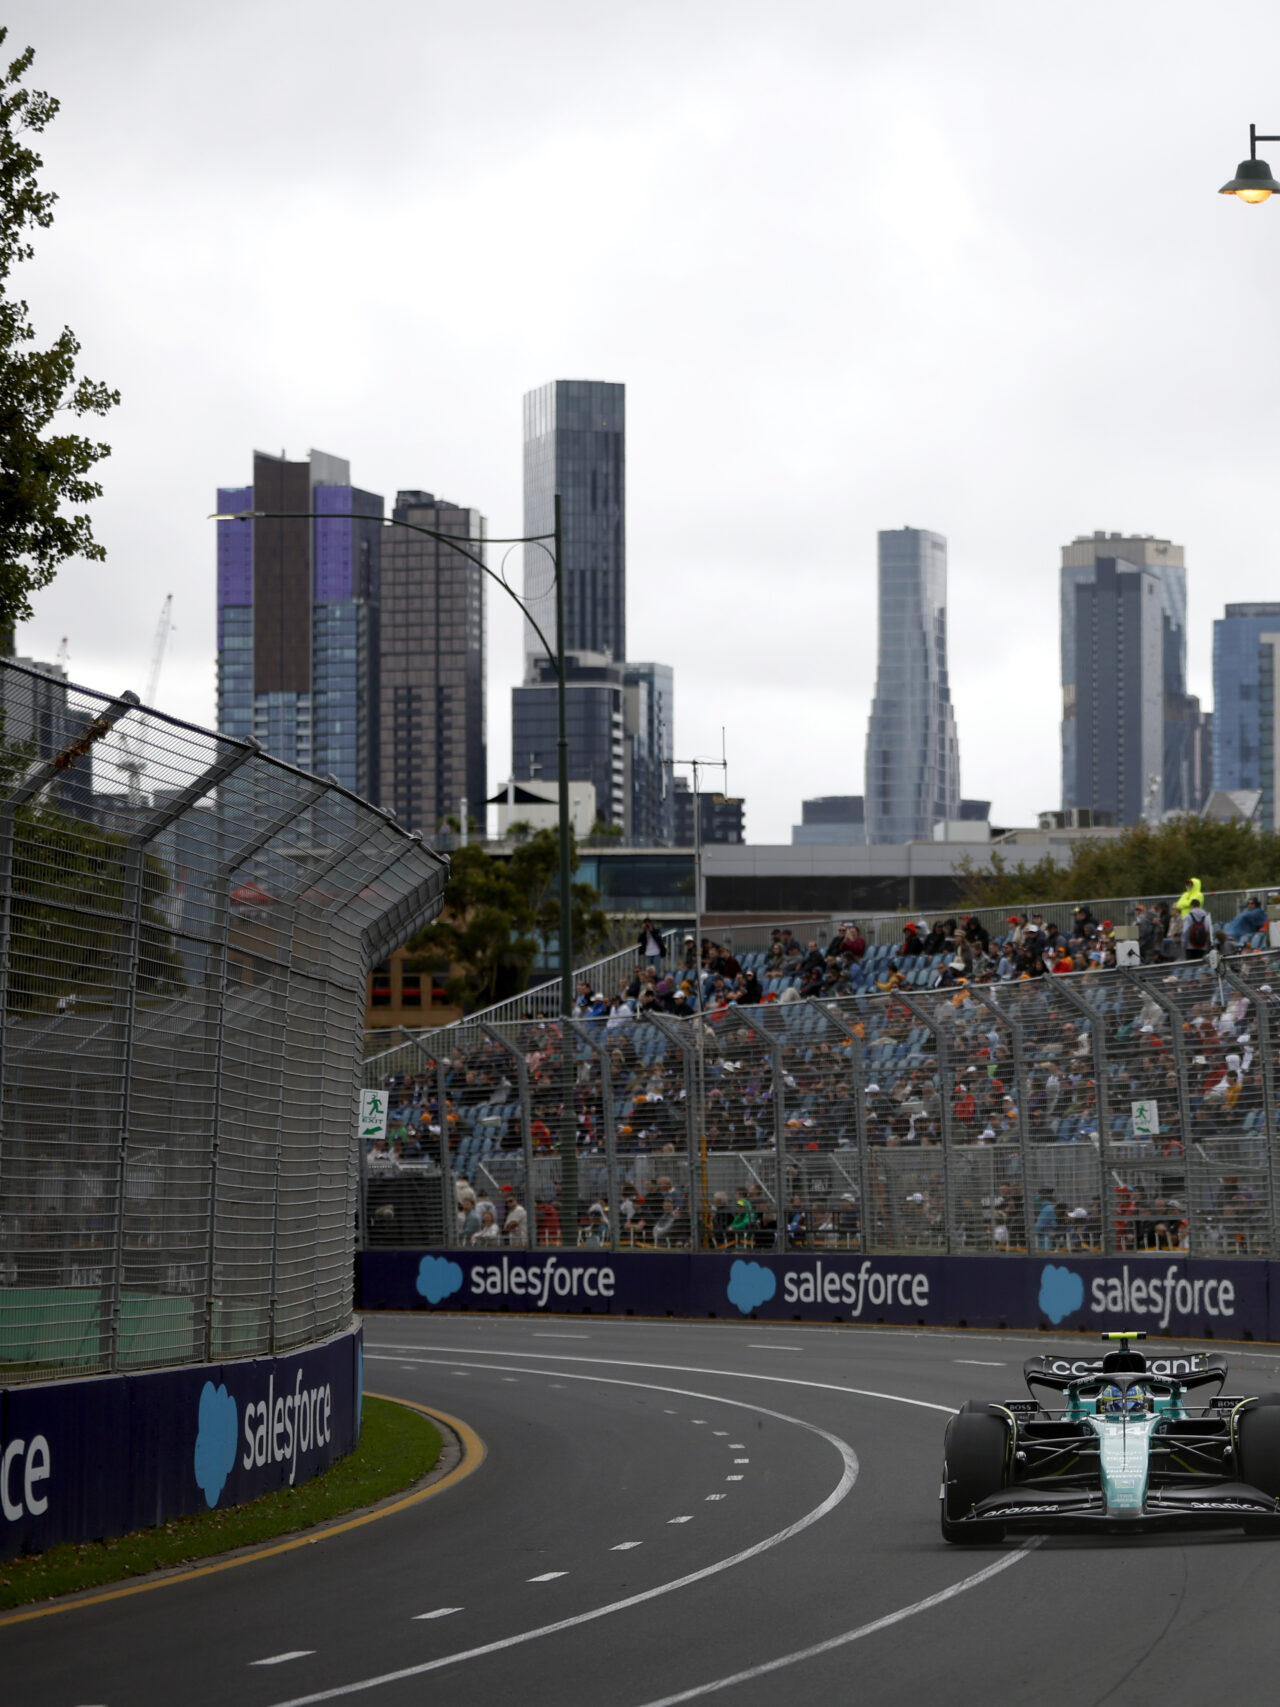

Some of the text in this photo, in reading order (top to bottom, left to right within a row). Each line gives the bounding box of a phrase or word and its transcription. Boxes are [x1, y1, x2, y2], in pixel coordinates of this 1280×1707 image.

[471, 1256, 616, 1307] salesforce
[783, 1260, 930, 1317] salesforce
[1090, 1265, 1236, 1329] salesforce
[243, 1367, 332, 1486] salesforce
[1105, 1426, 1143, 1436] 14
[0, 1434, 51, 1522] ce
[983, 1505, 1059, 1517] aramco
[1190, 1501, 1267, 1512] aramco
